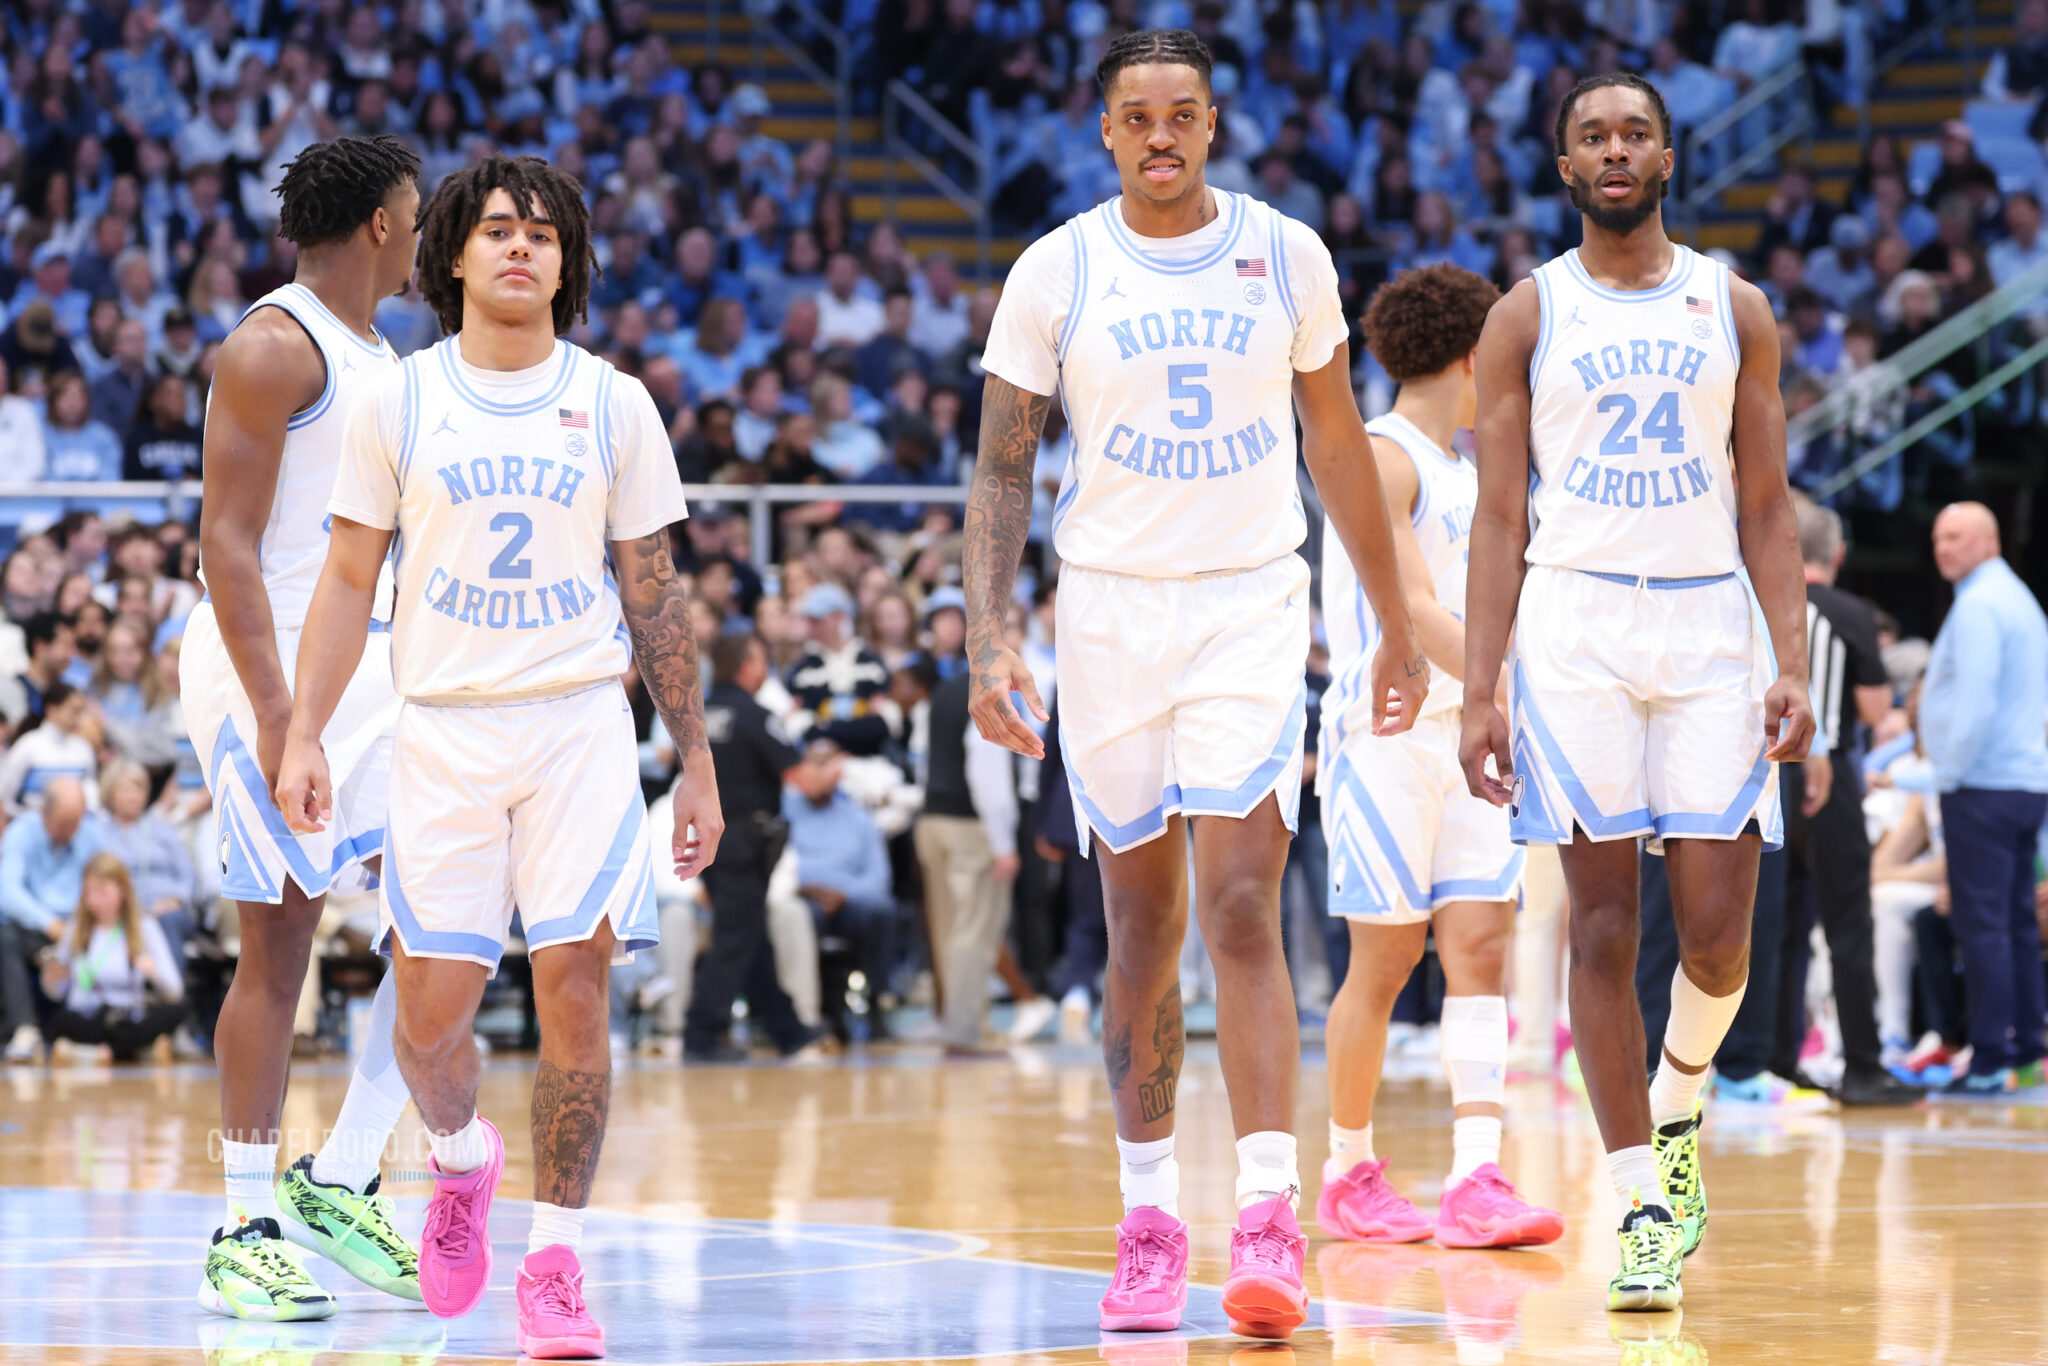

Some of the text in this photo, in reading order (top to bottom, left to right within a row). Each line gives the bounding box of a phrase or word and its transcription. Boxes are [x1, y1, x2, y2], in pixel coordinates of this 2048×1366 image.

[1107, 309, 1256, 360] NORTH
[1571, 339, 1708, 392] NORTH
[1168, 363, 1213, 430] 5
[1597, 392, 1685, 456] 24
[1103, 416, 1279, 480] CAROLINA
[437, 455, 585, 508] NORTH
[489, 512, 533, 579] 2
[424, 567, 596, 629] CAROLINA
